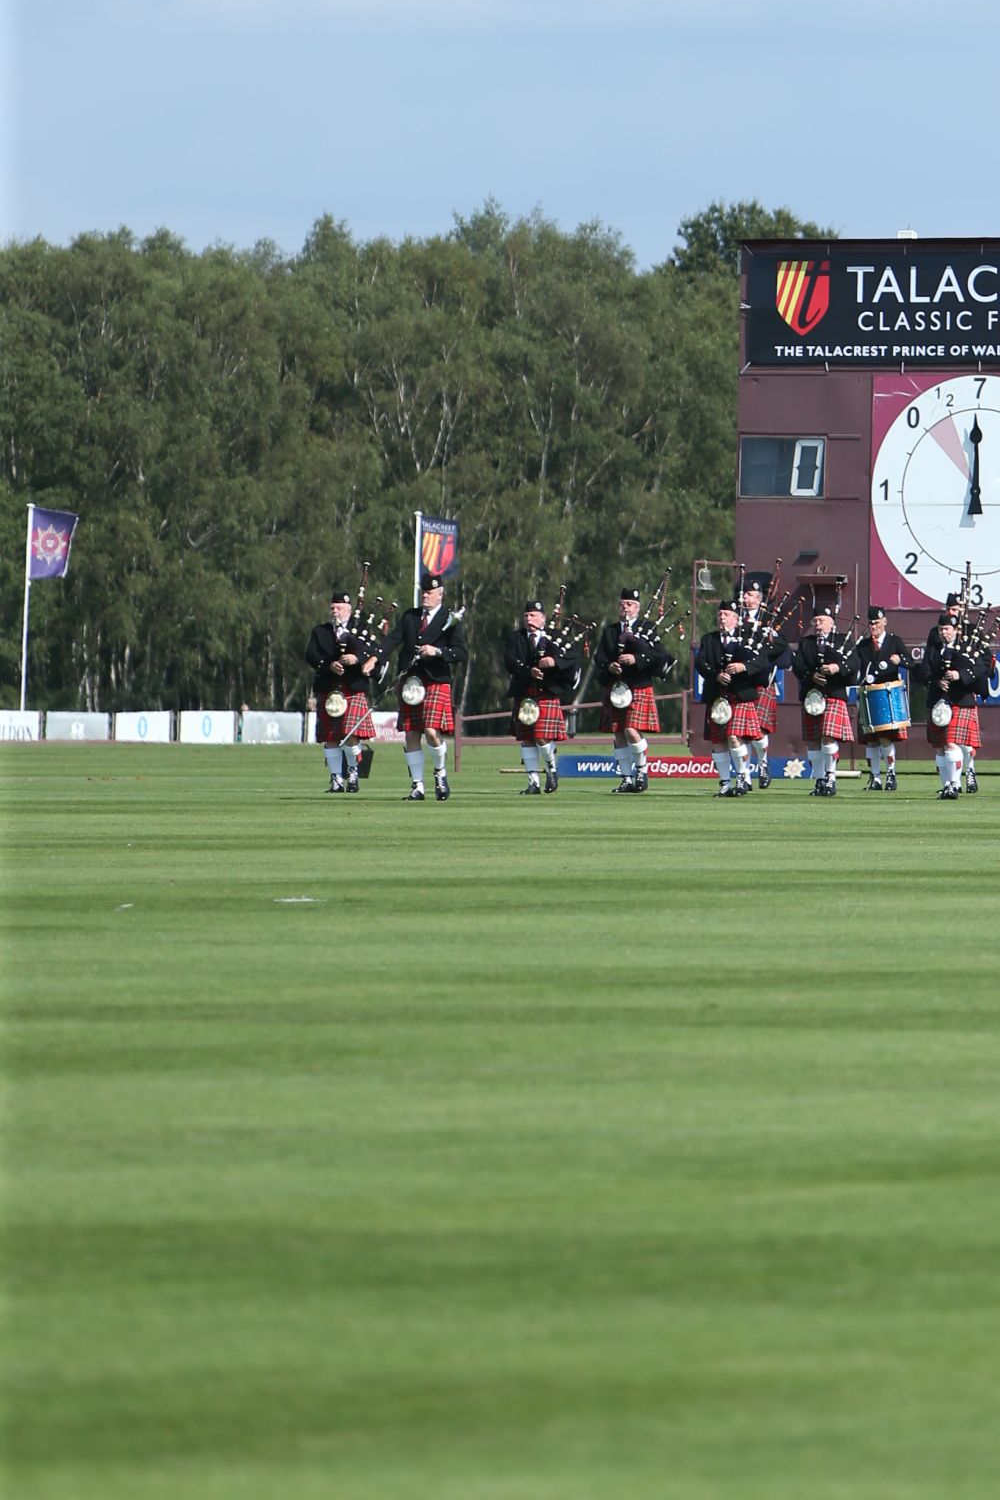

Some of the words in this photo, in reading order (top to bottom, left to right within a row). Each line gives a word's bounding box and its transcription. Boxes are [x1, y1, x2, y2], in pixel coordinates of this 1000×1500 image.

[857, 311, 973, 331] CLASSIC
[775, 345, 803, 357] THE
[806, 345, 888, 357] TALACREST
[892, 345, 945, 356] PRINCE
[949, 344, 969, 356] OF
[934, 386, 941, 400] 1
[973, 377, 987, 399] 7
[945, 394, 954, 407] 2
[906, 406, 920, 429] 0
[879, 478, 889, 501] 1
[904, 552, 918, 574] 2
[970, 584, 984, 606] 3
